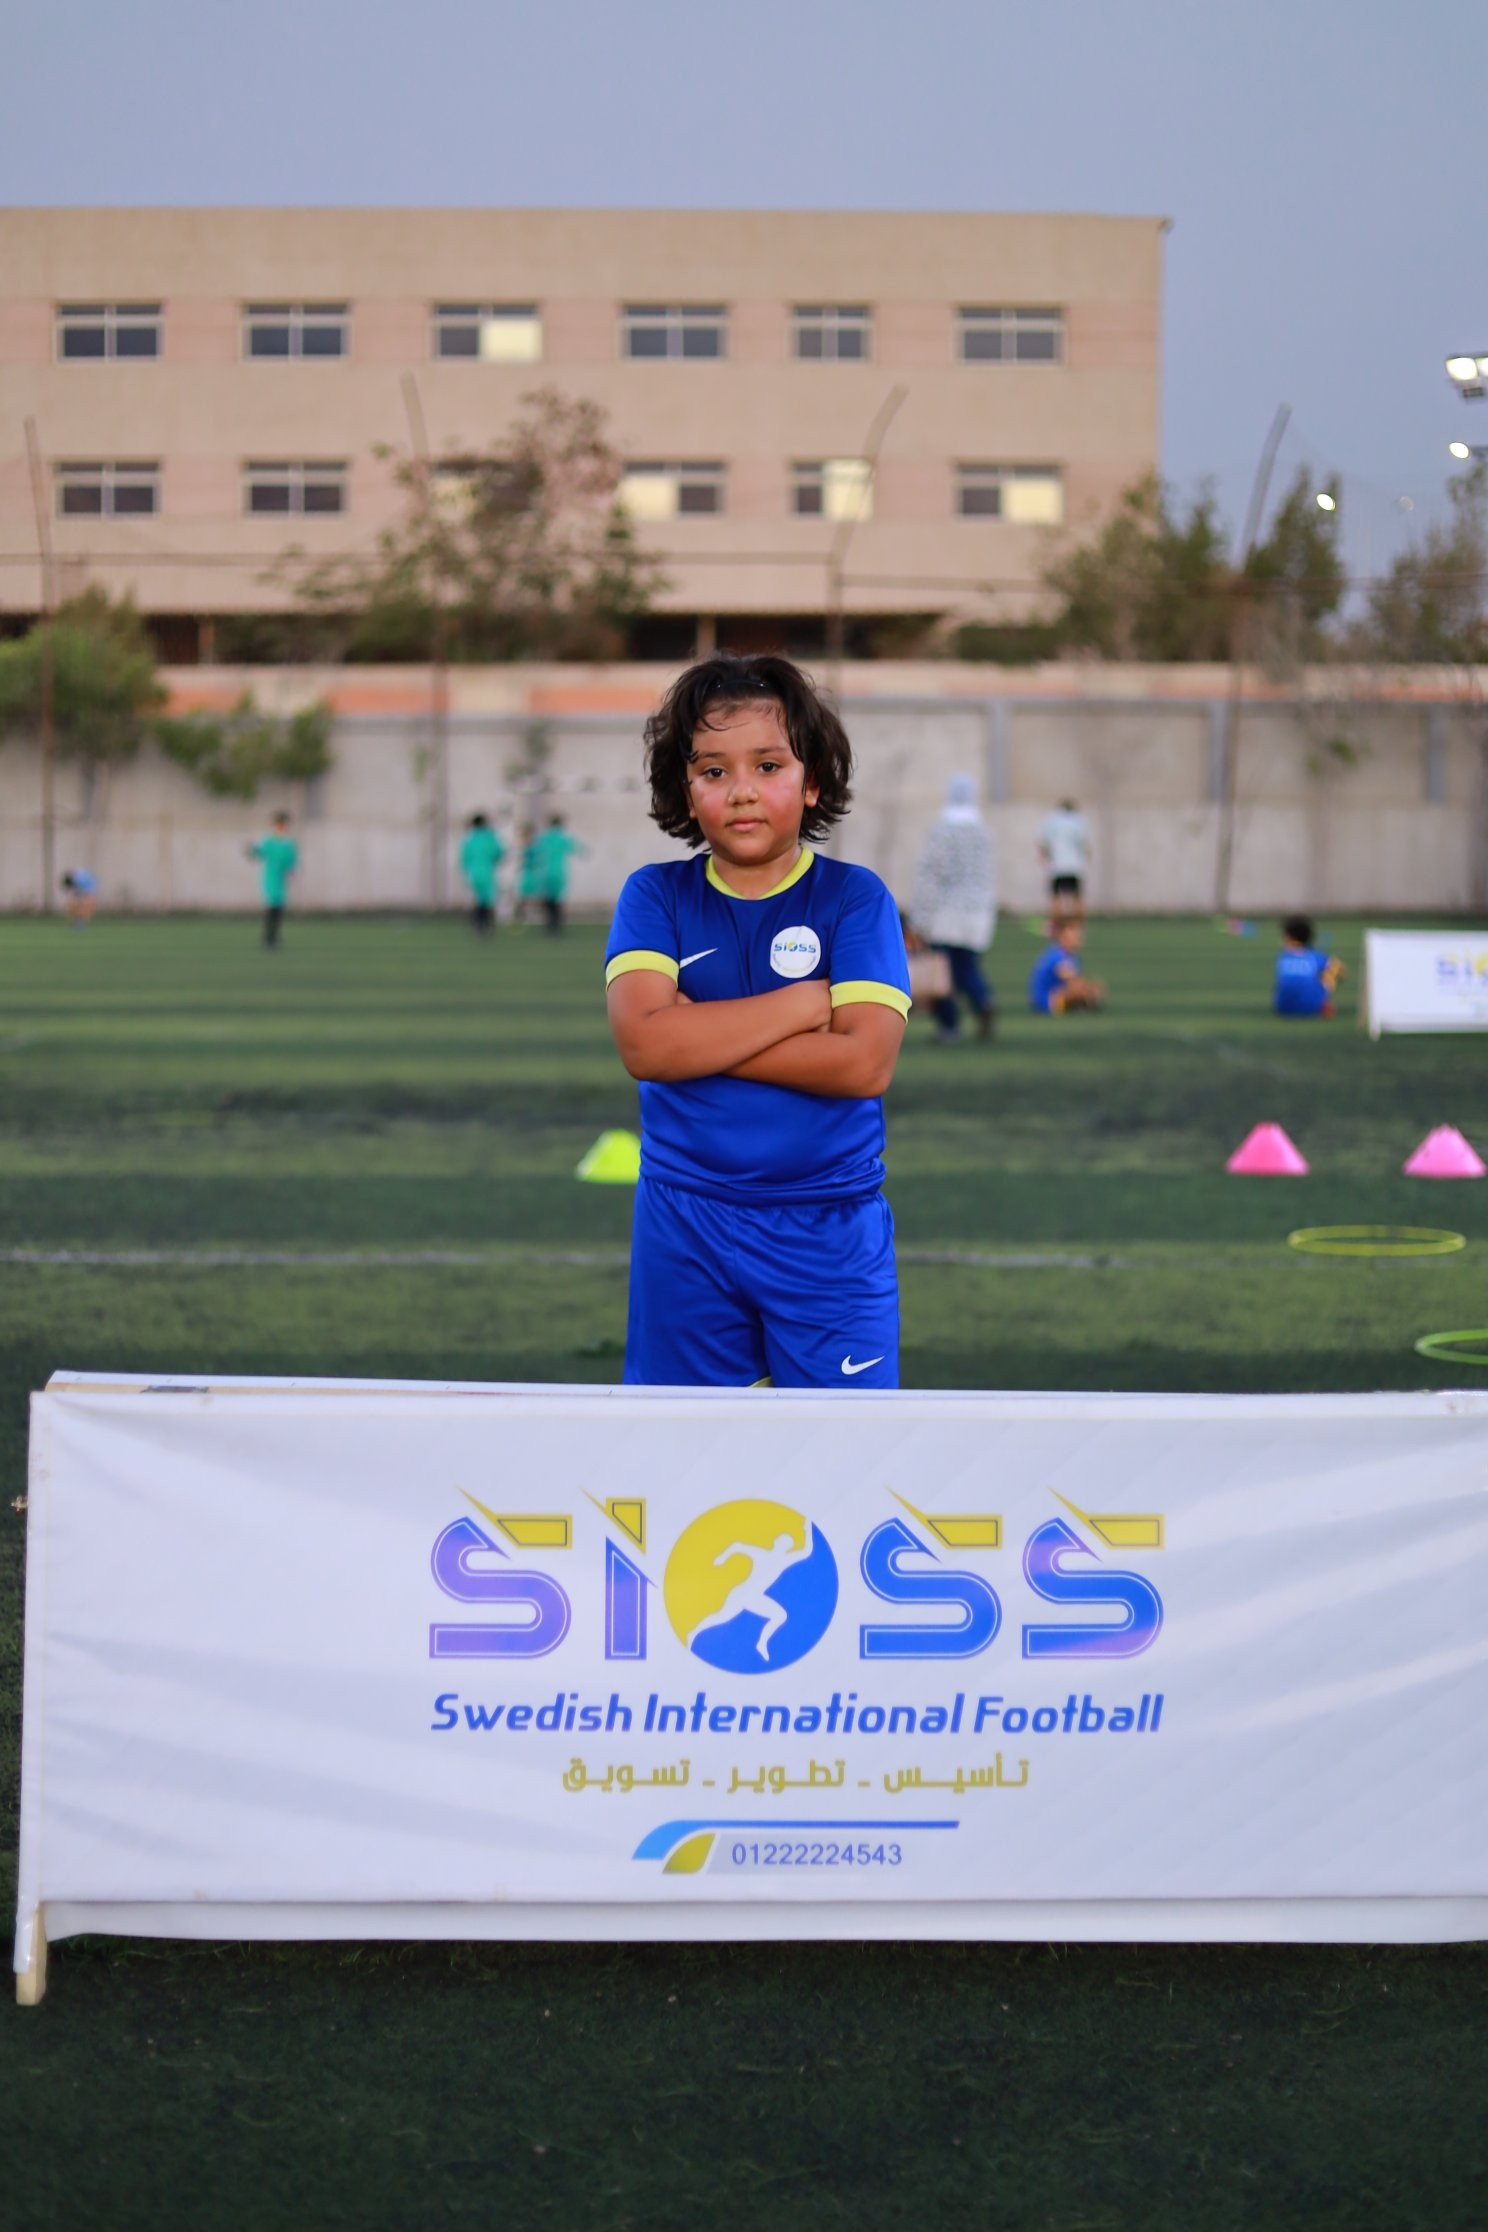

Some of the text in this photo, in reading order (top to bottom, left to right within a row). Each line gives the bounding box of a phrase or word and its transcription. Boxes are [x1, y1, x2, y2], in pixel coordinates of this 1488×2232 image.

[431, 1691, 1165, 1734] Swedish International Football
[562, 1758, 690, 1793] تسويق
[727, 1760, 845, 1793] تطوير
[884, 1752, 1029, 1794] تأسيس
[732, 1843, 903, 1866] 01222224543
